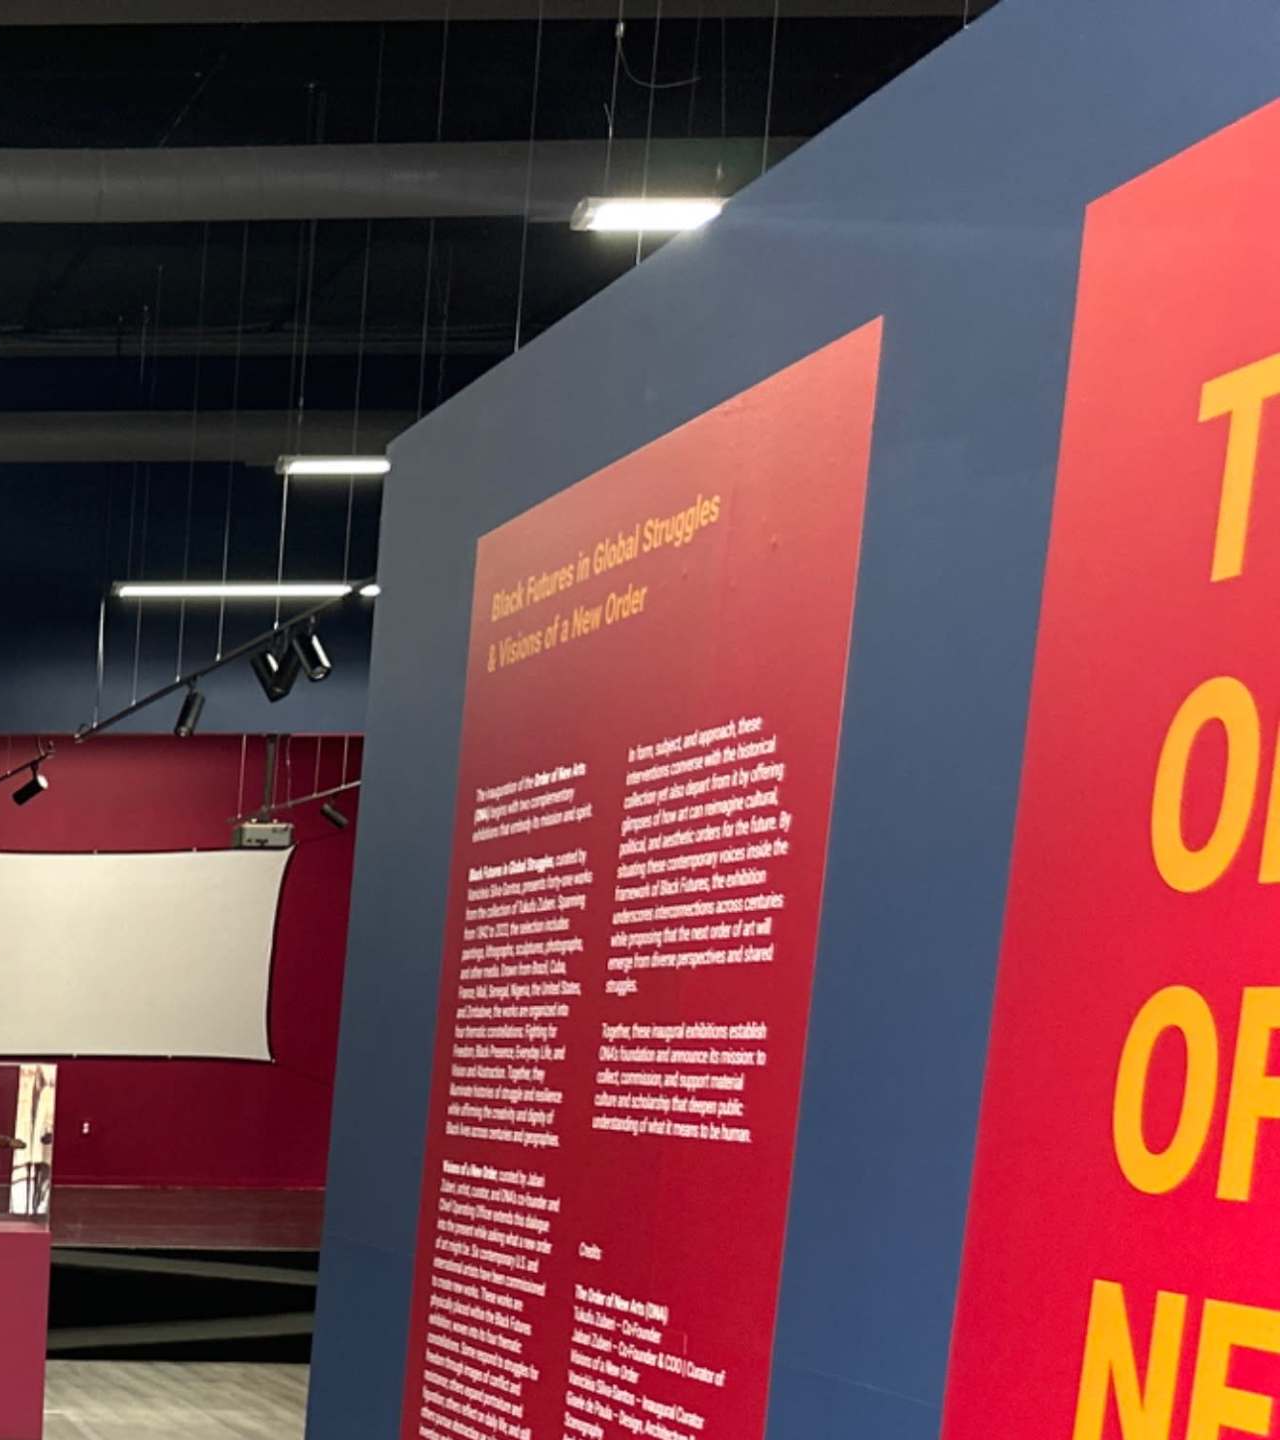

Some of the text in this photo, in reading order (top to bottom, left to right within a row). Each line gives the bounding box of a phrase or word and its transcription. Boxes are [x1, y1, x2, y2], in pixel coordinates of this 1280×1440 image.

[492, 493, 721, 622] Black Futures in Global Struggles
[487, 643, 497, 673] &
[499, 628, 543, 668] Visions
[544, 612, 561, 650] of
[571, 604, 604, 639] New
[605, 583, 648, 626] Order
[1151, 675, 1280, 893] O
